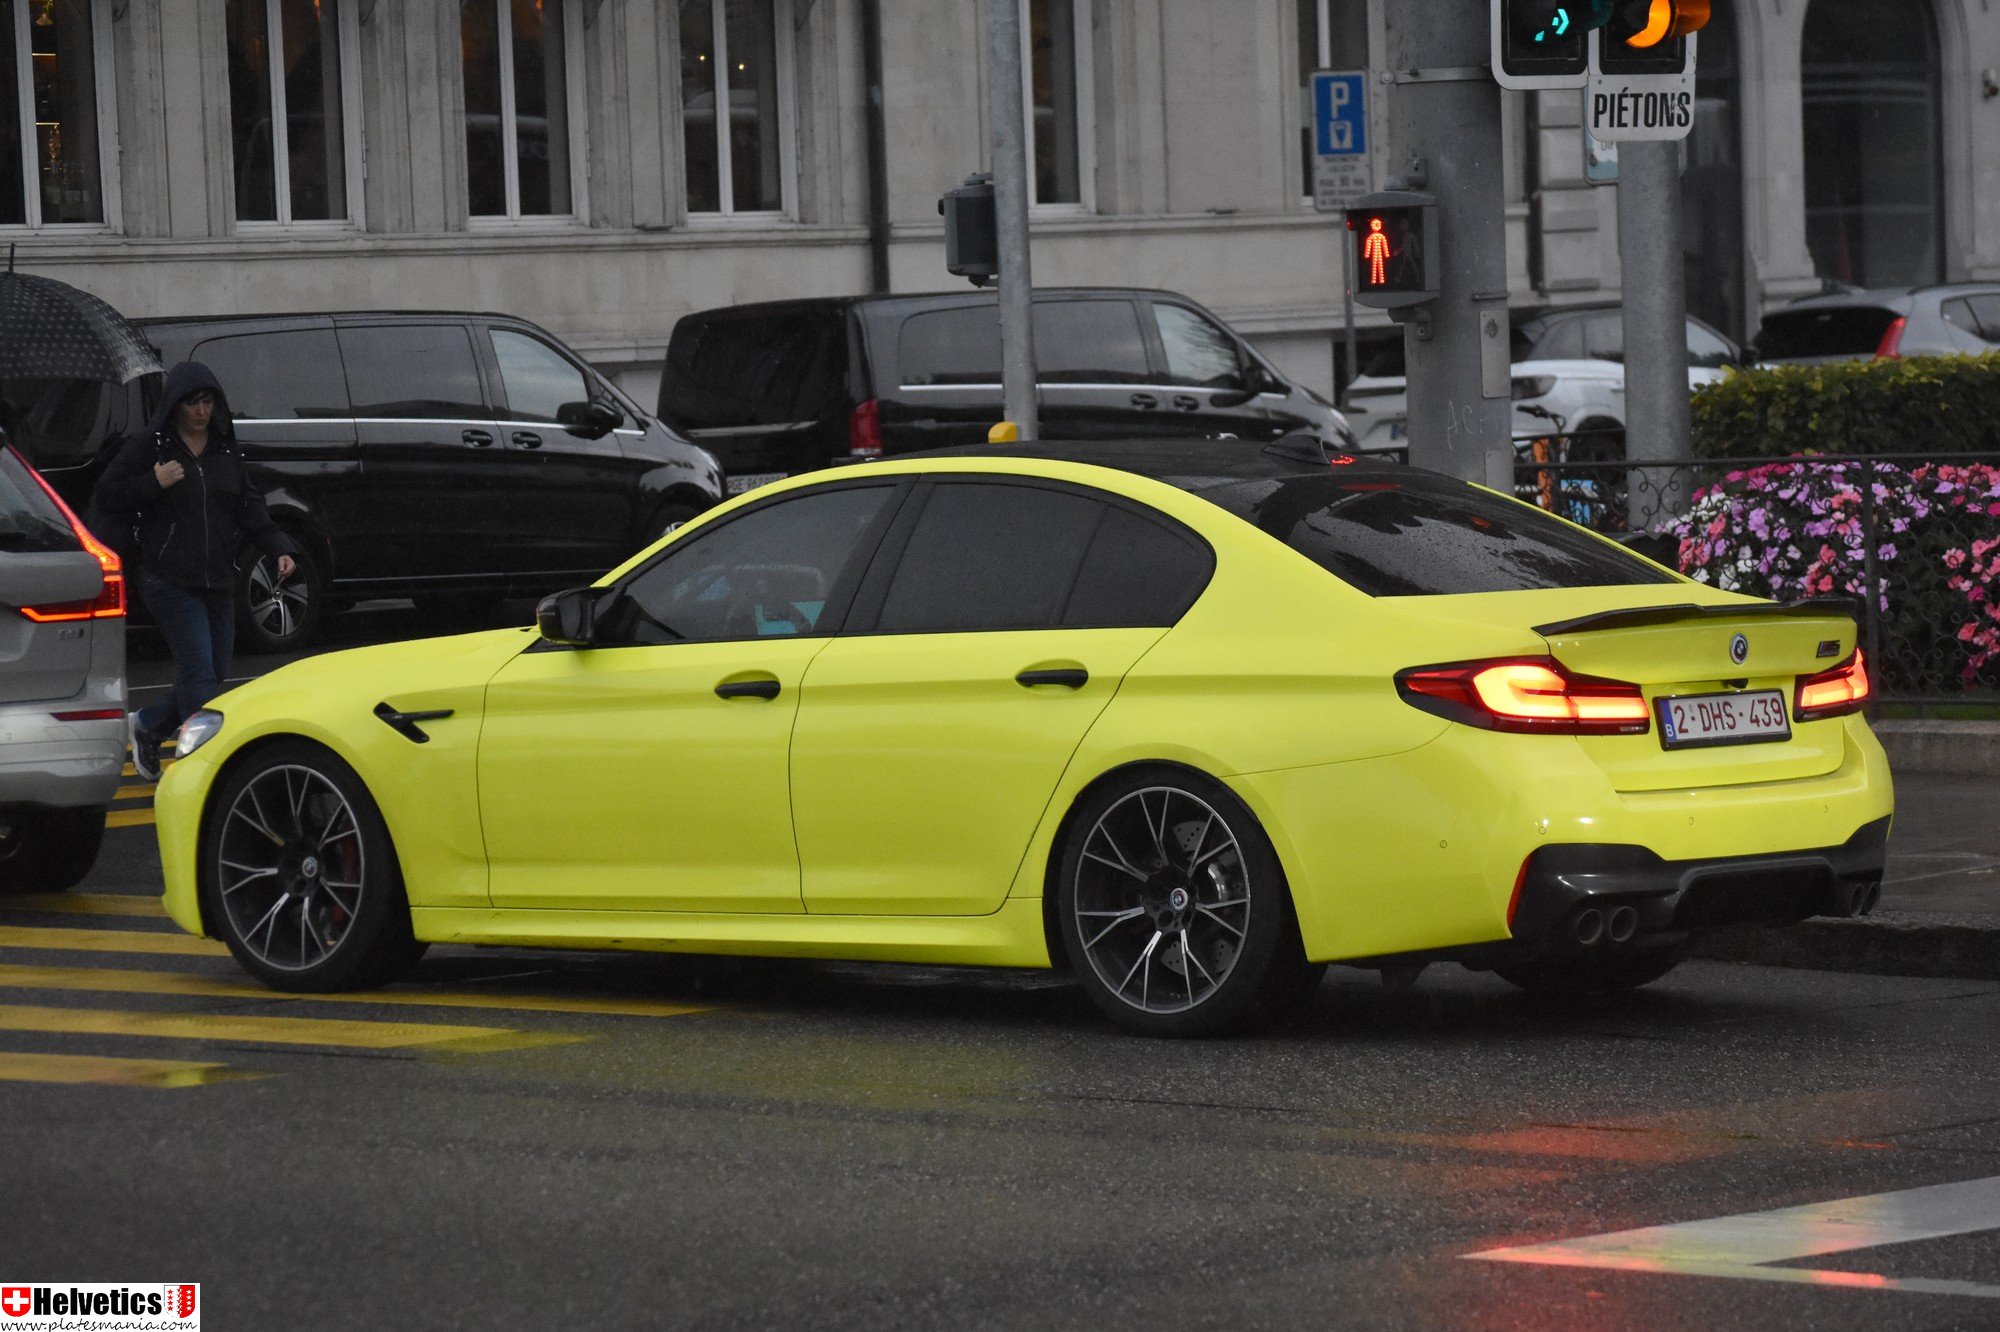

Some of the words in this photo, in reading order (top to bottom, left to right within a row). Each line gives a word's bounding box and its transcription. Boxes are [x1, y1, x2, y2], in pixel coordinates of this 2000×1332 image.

[1329, 81, 1350, 119] P
[1593, 86, 1691, 128] PIÉTONS
[1664, 723, 1674, 738] B
